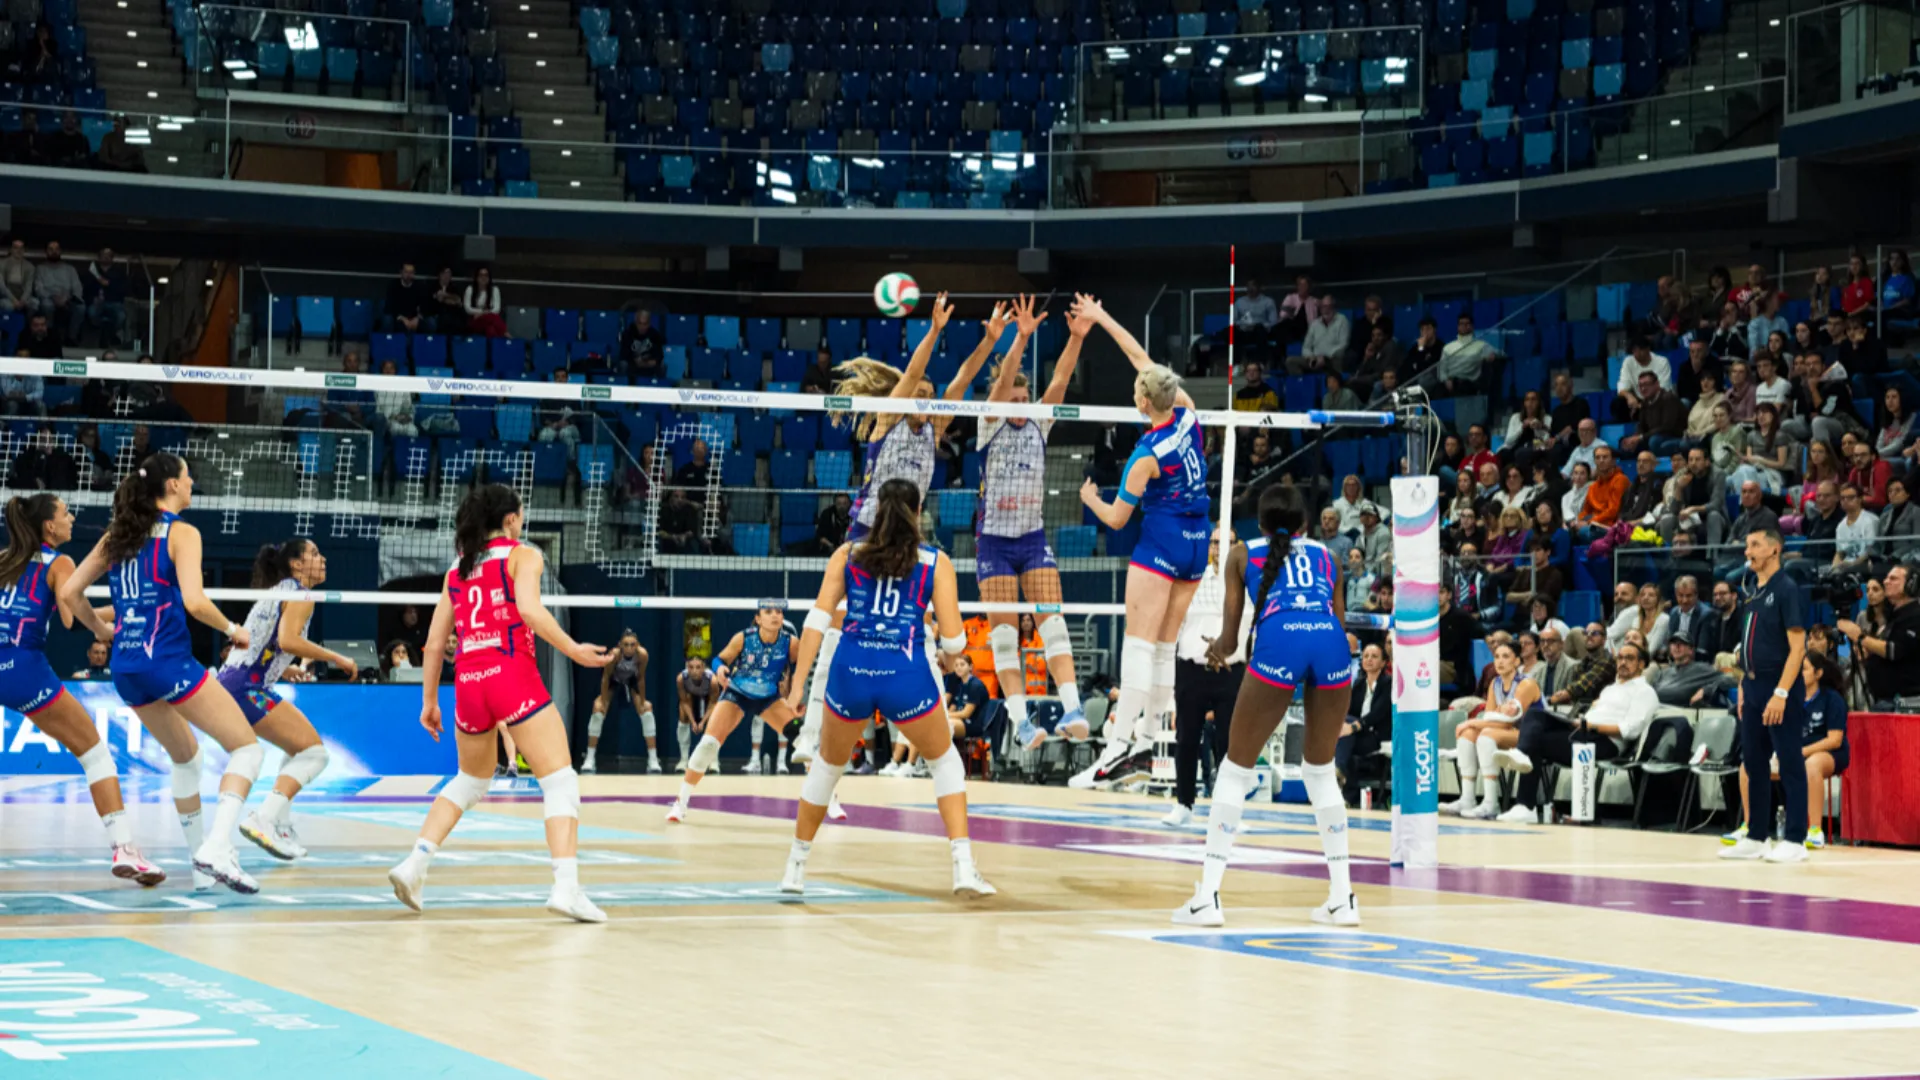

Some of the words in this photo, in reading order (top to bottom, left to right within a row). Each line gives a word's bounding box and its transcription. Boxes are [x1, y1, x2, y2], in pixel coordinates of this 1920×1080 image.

[181, 370, 254, 380] VEROVOLLEY
[445, 383, 513, 392] VEROVOLLEY
[1183, 447, 1202, 487] 19
[120, 557, 140, 600] 10
[1284, 554, 1314, 588] 18
[468, 585, 486, 629] 2
[870, 575, 899, 618] 15
[896, 698, 933, 720] UNIKA
[1581, 765, 1590, 785] Data
[1579, 787, 1590, 817] Project
[1243, 938, 1818, 1010] FINECO
